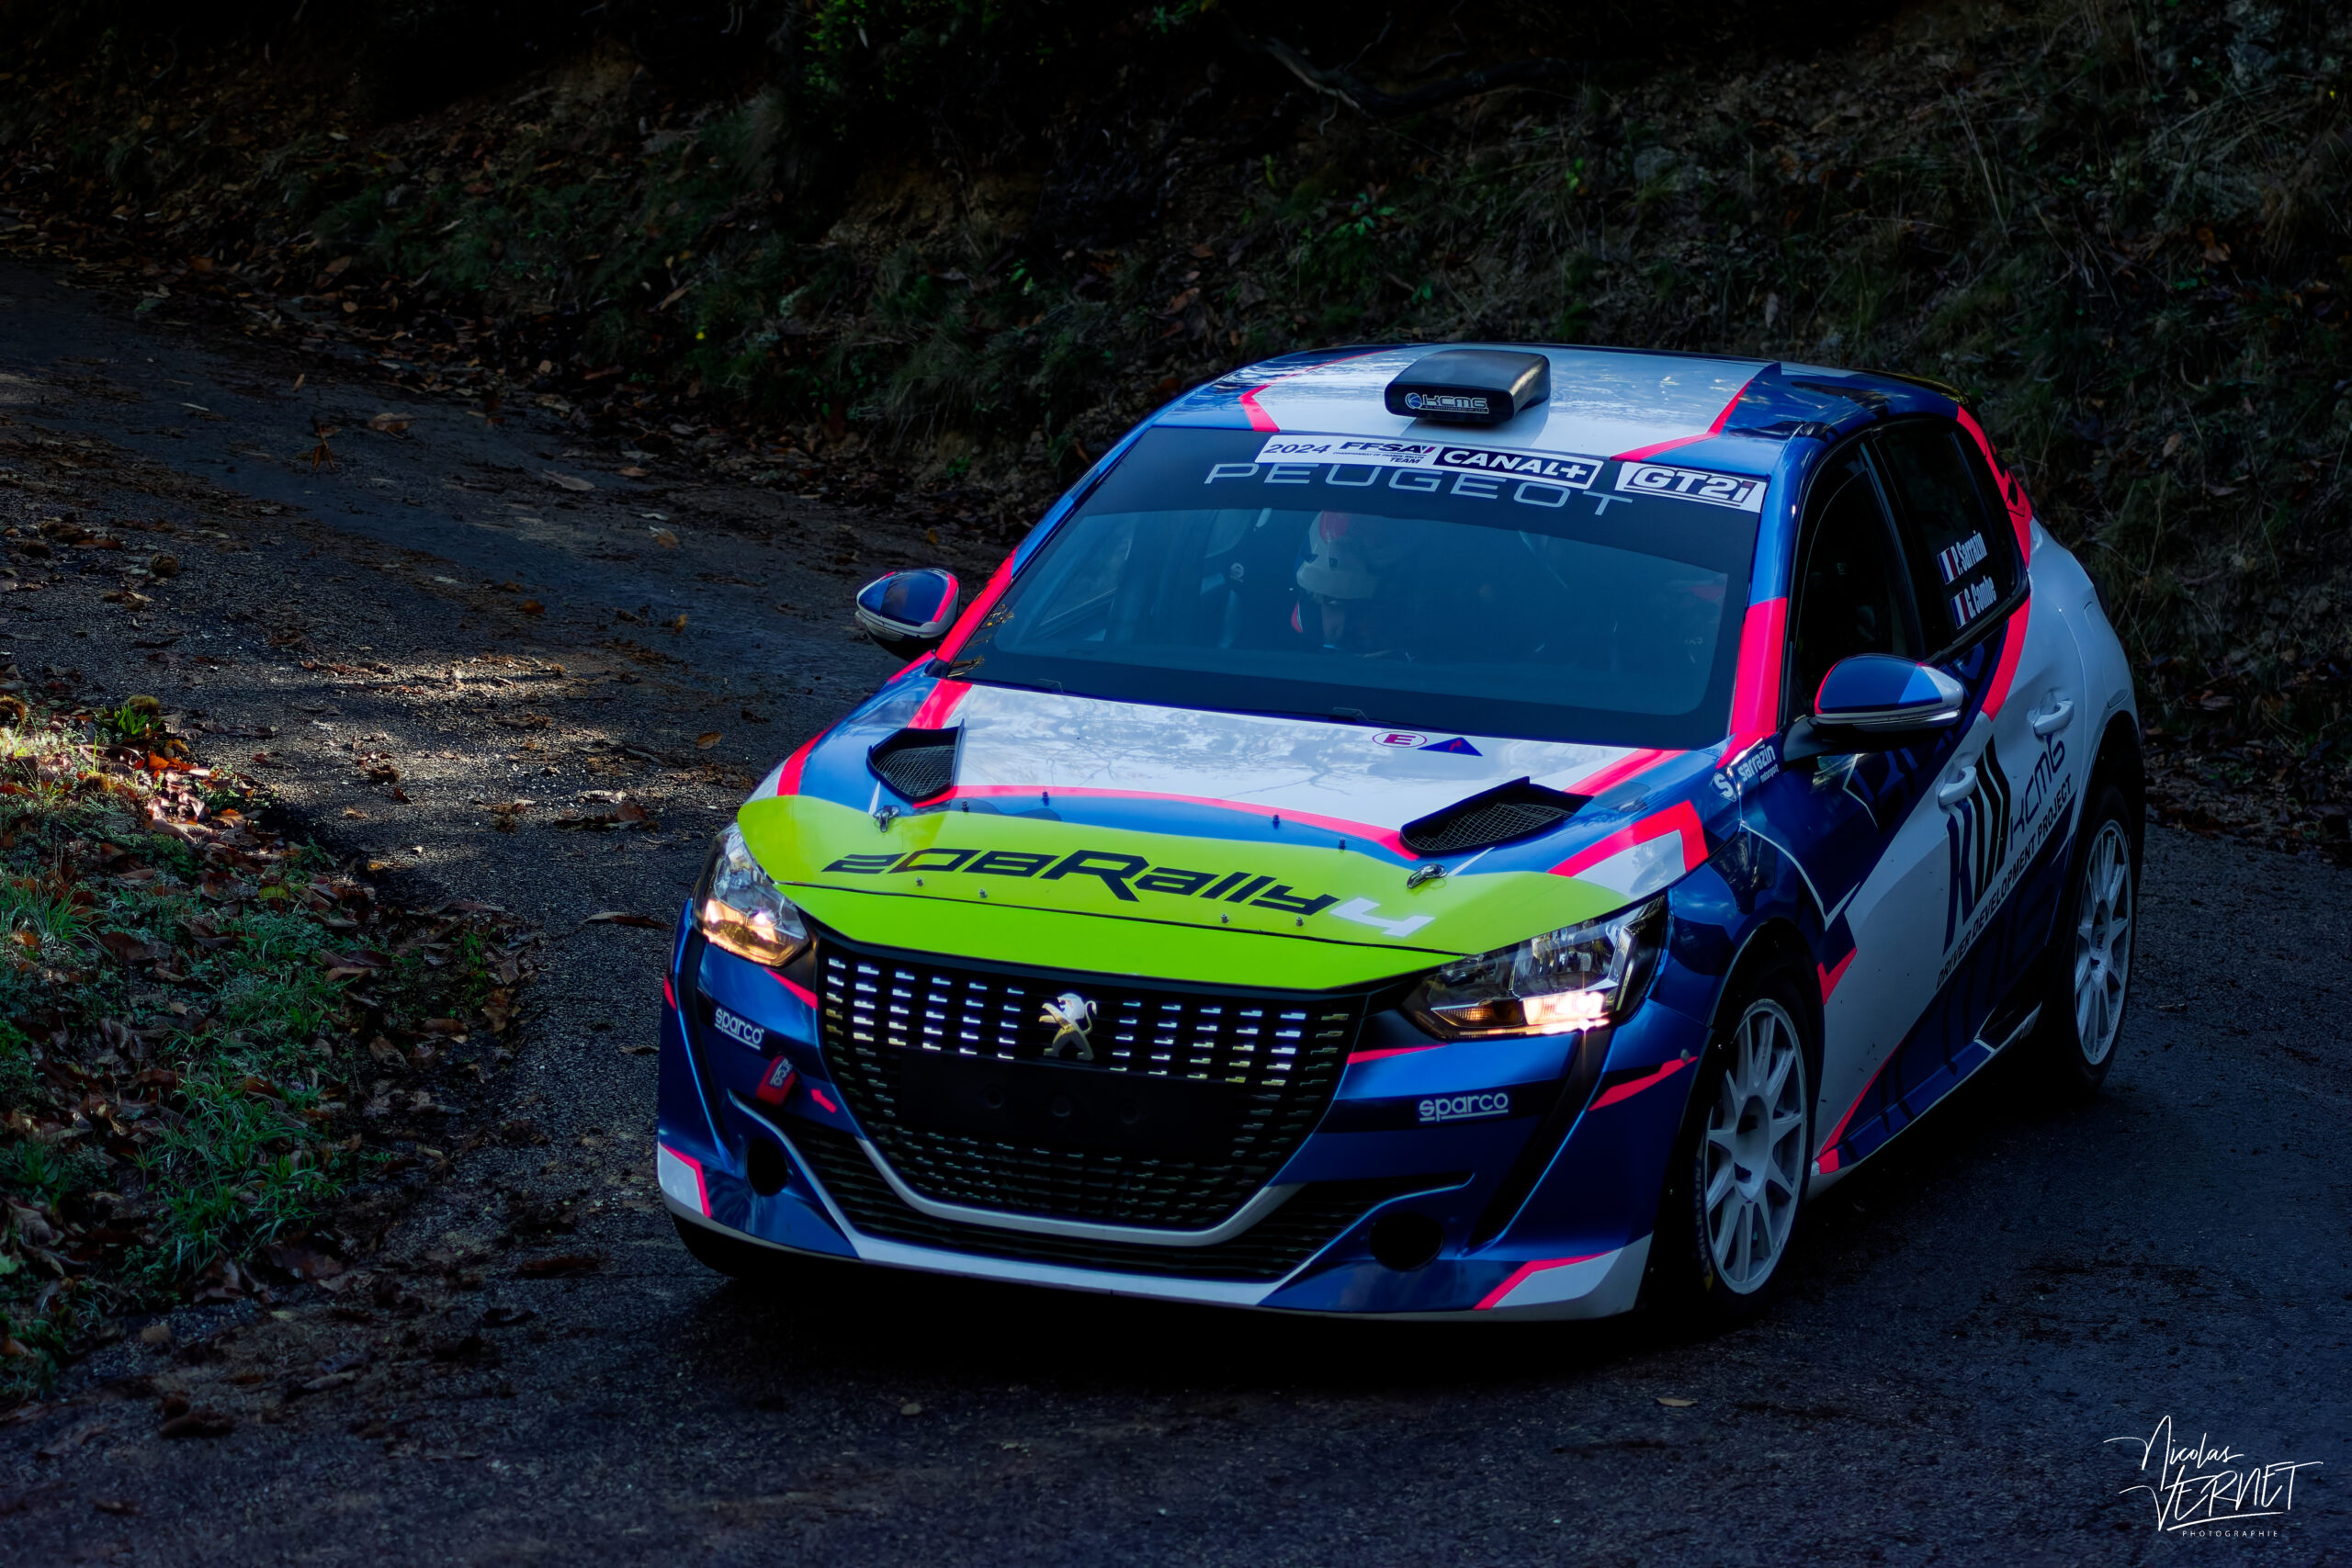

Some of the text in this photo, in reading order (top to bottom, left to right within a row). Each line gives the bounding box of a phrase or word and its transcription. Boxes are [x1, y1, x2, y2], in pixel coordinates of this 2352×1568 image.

[1262, 444, 1332, 455] 2024
[1340, 441, 1424, 454] FFSA
[1442, 450, 1589, 480] CANAL+
[1204, 462, 1634, 517] PEUGEOT
[1631, 466, 1753, 505] GT2i
[1383, 733, 1417, 746] E
[1936, 929, 1972, 989] DRIVER
[1972, 833, 2037, 941] DEVELOPMENT
[2037, 773, 2072, 846] PROJECT
[715, 1008, 764, 1049] sparco
[1419, 1092, 1510, 1122] sparco
